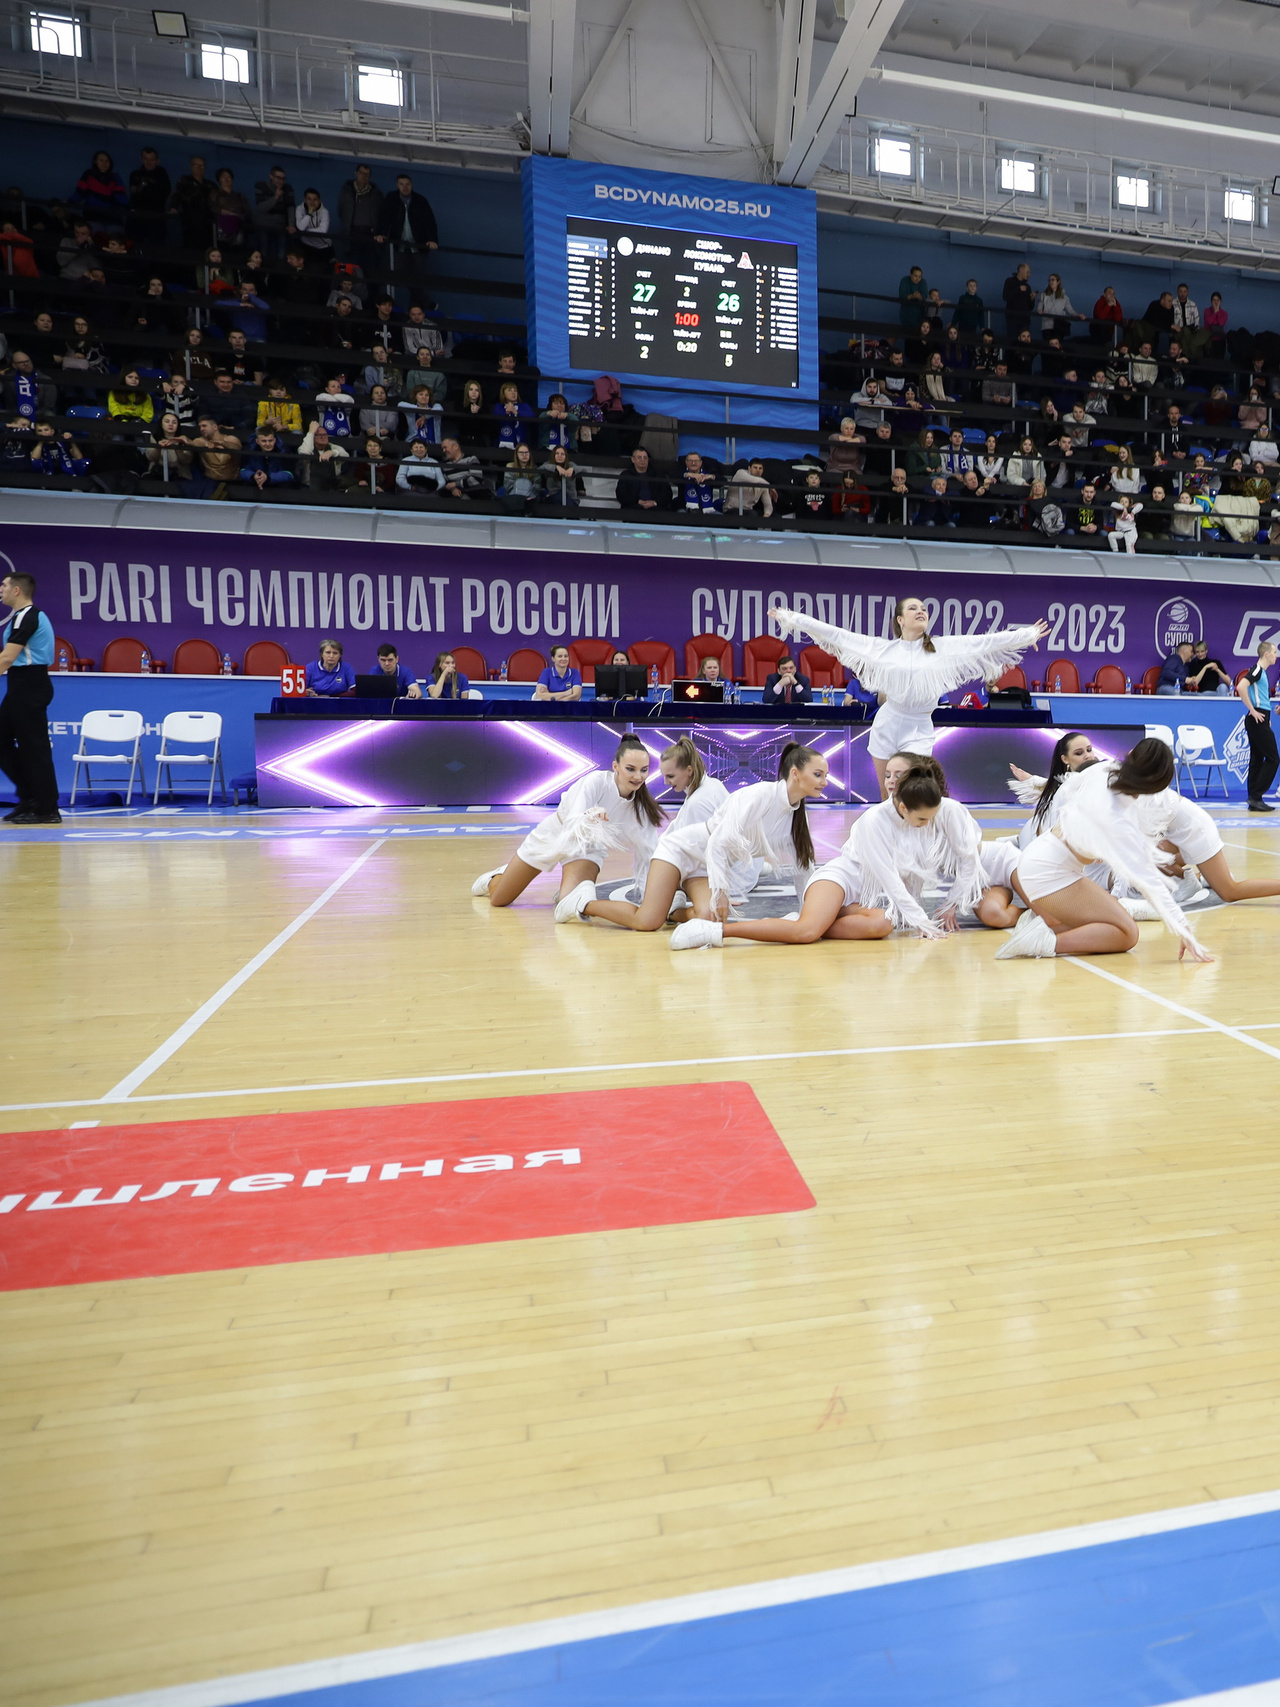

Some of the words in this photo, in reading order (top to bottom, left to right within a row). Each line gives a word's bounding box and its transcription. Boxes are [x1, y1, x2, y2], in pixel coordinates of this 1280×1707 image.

[595, 184, 771, 218] BCDYNAMO25.RU
[635, 244, 671, 256] ДИНАМО
[632, 283, 656, 302] 27
[683, 287, 690, 297] 2
[717, 293, 740, 312] 26
[675, 312, 699, 326] 1:00
[640, 345, 649, 359] 2
[677, 341, 697, 353] 0:20
[724, 354, 733, 367] 5
[69, 561, 172, 624] PARI
[462, 578, 620, 638] РОССИИ
[282, 668, 306, 694] 55
